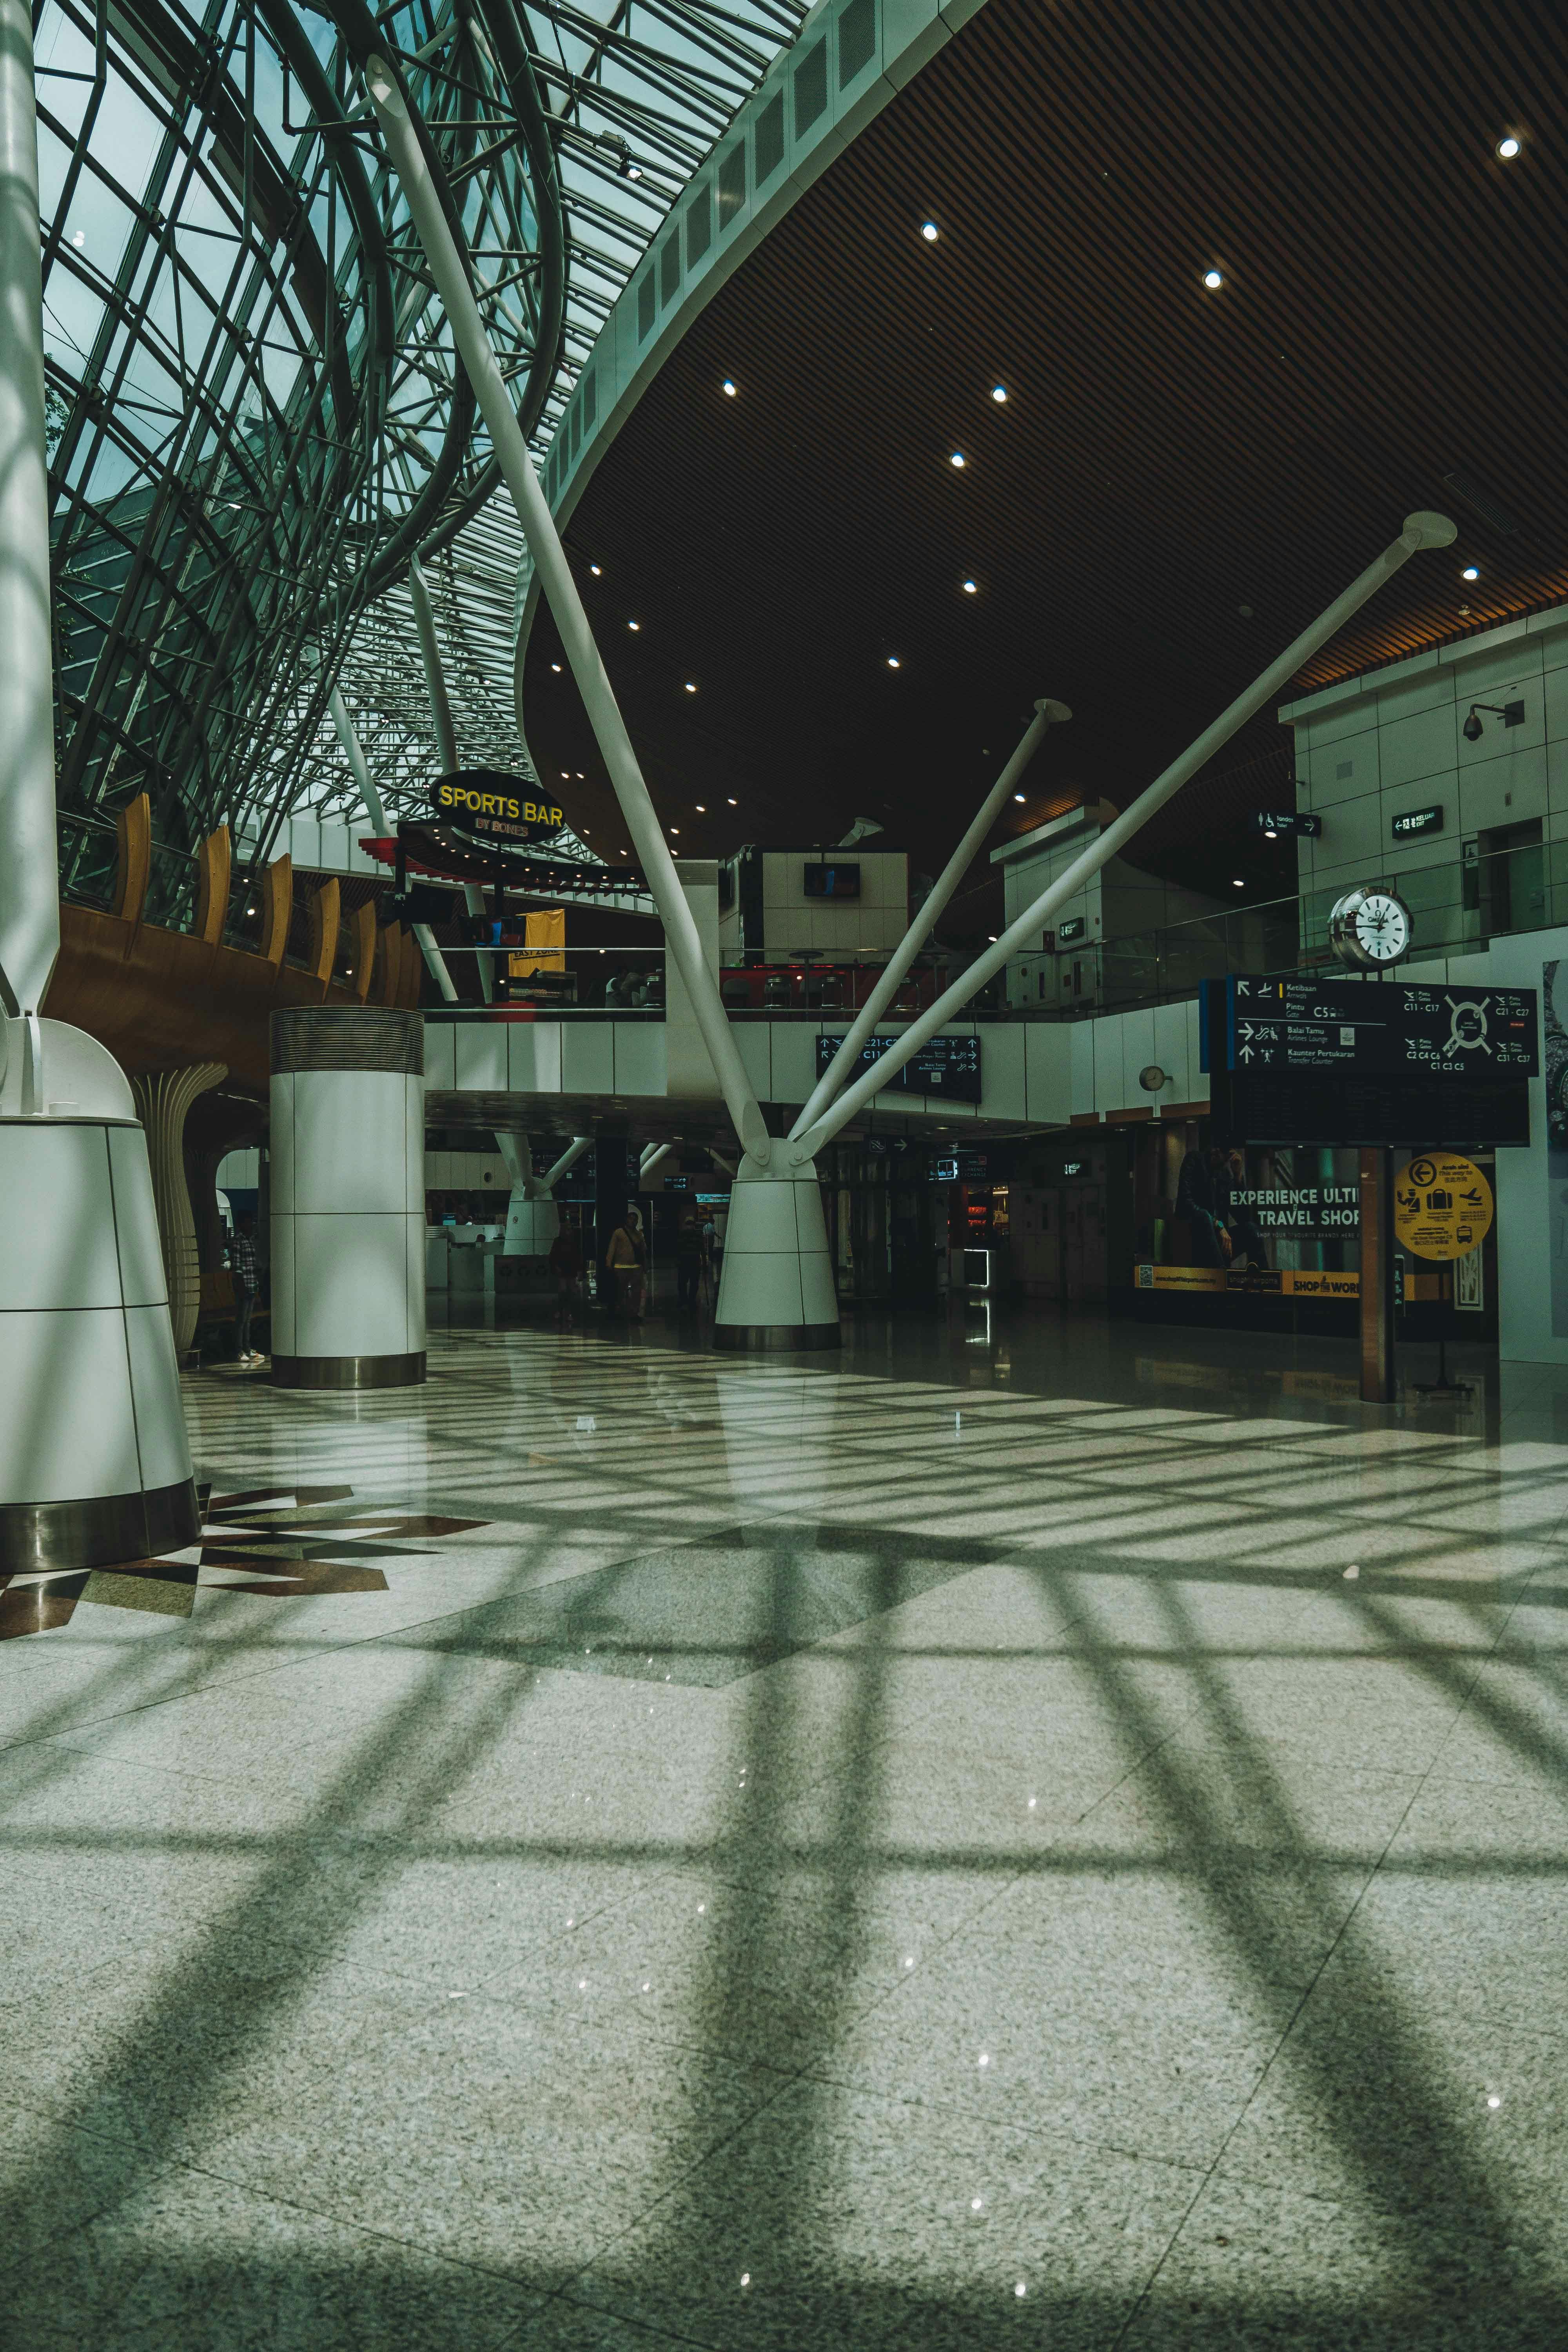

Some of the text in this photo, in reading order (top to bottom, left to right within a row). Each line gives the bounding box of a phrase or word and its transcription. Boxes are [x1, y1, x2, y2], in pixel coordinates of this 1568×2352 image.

[439, 785, 563, 827] SPORTS BAR
[475, 817, 529, 837] BY BONES
[1314, 1007, 1328, 1017] C5
[1288, 1048, 1315, 1056] Kaunter
[1230, 1187, 1359, 1205] EXPERIENCE ULTI
[1258, 1210, 1314, 1225] TRAVEL
[1294, 1280, 1319, 1292] SHOP
